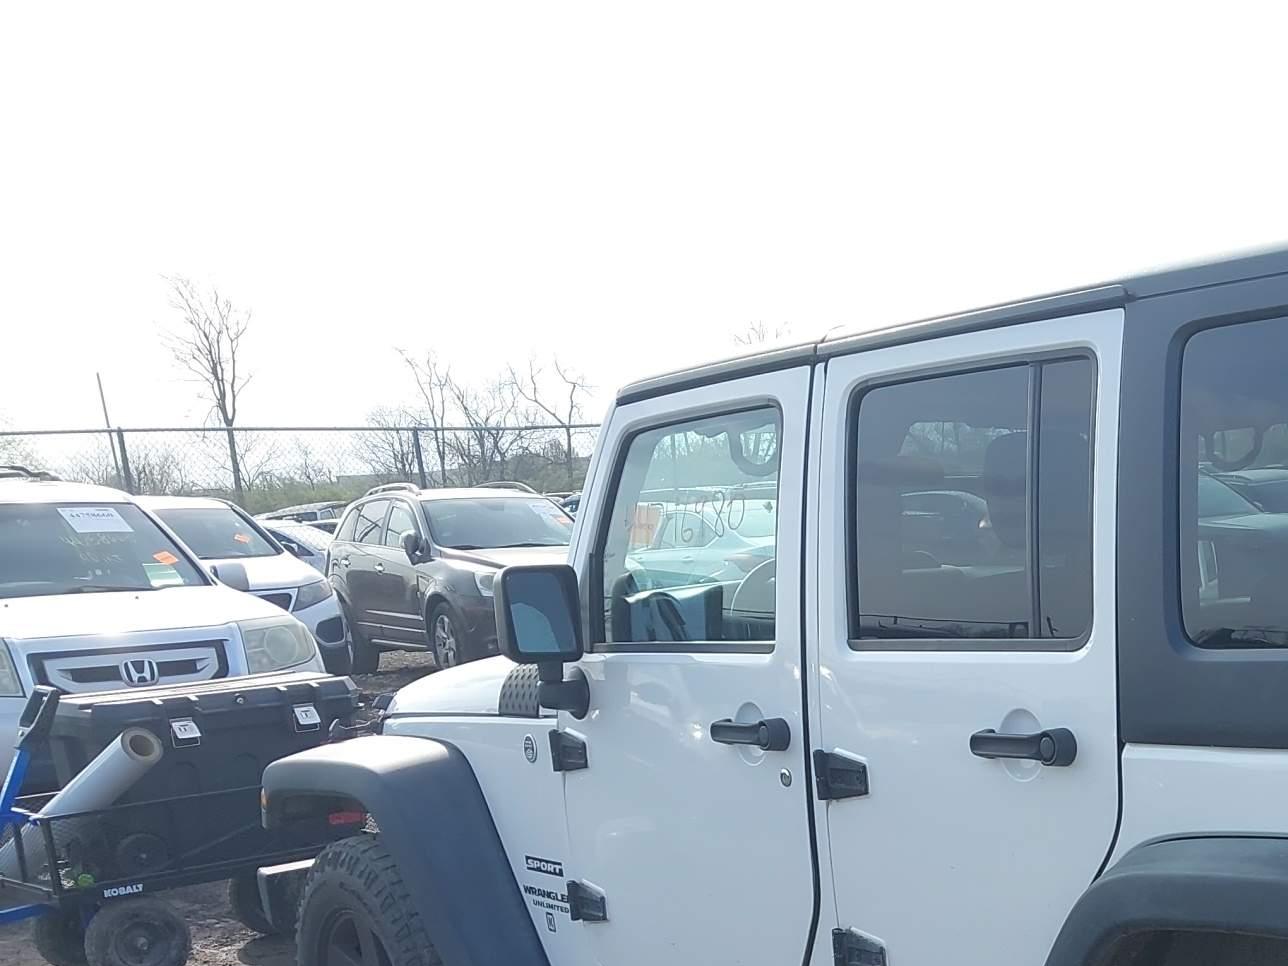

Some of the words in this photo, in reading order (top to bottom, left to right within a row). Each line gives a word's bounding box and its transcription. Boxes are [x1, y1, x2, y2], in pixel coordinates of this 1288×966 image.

[526, 858, 562, 874] SPORT
[103, 883, 143, 898] KOBALT
[523, 884, 568, 903] WRANGLE
[532, 898, 570, 914] UNLIMITED
